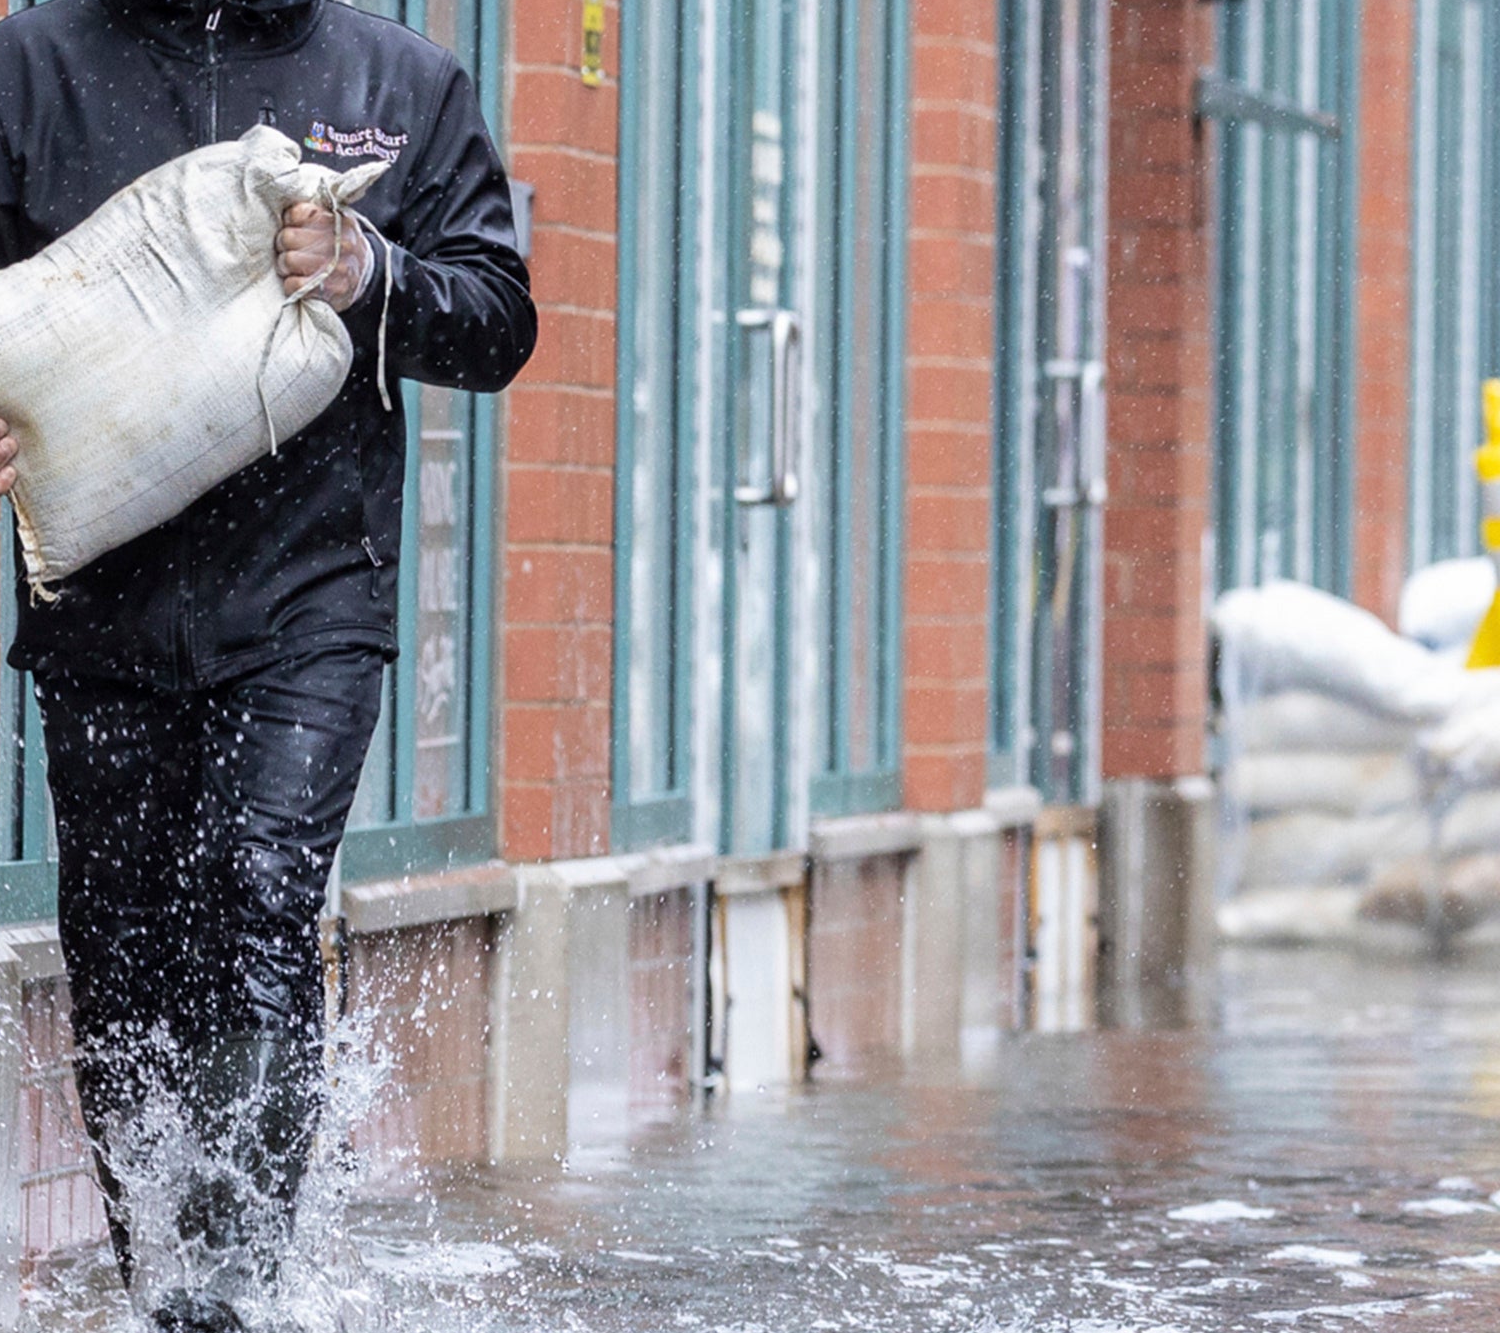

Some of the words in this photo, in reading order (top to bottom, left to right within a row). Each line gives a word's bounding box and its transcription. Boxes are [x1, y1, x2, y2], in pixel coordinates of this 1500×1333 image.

[327, 126, 373, 143] Smart
[374, 127, 409, 146] Start
[335, 141, 400, 163] Academy
